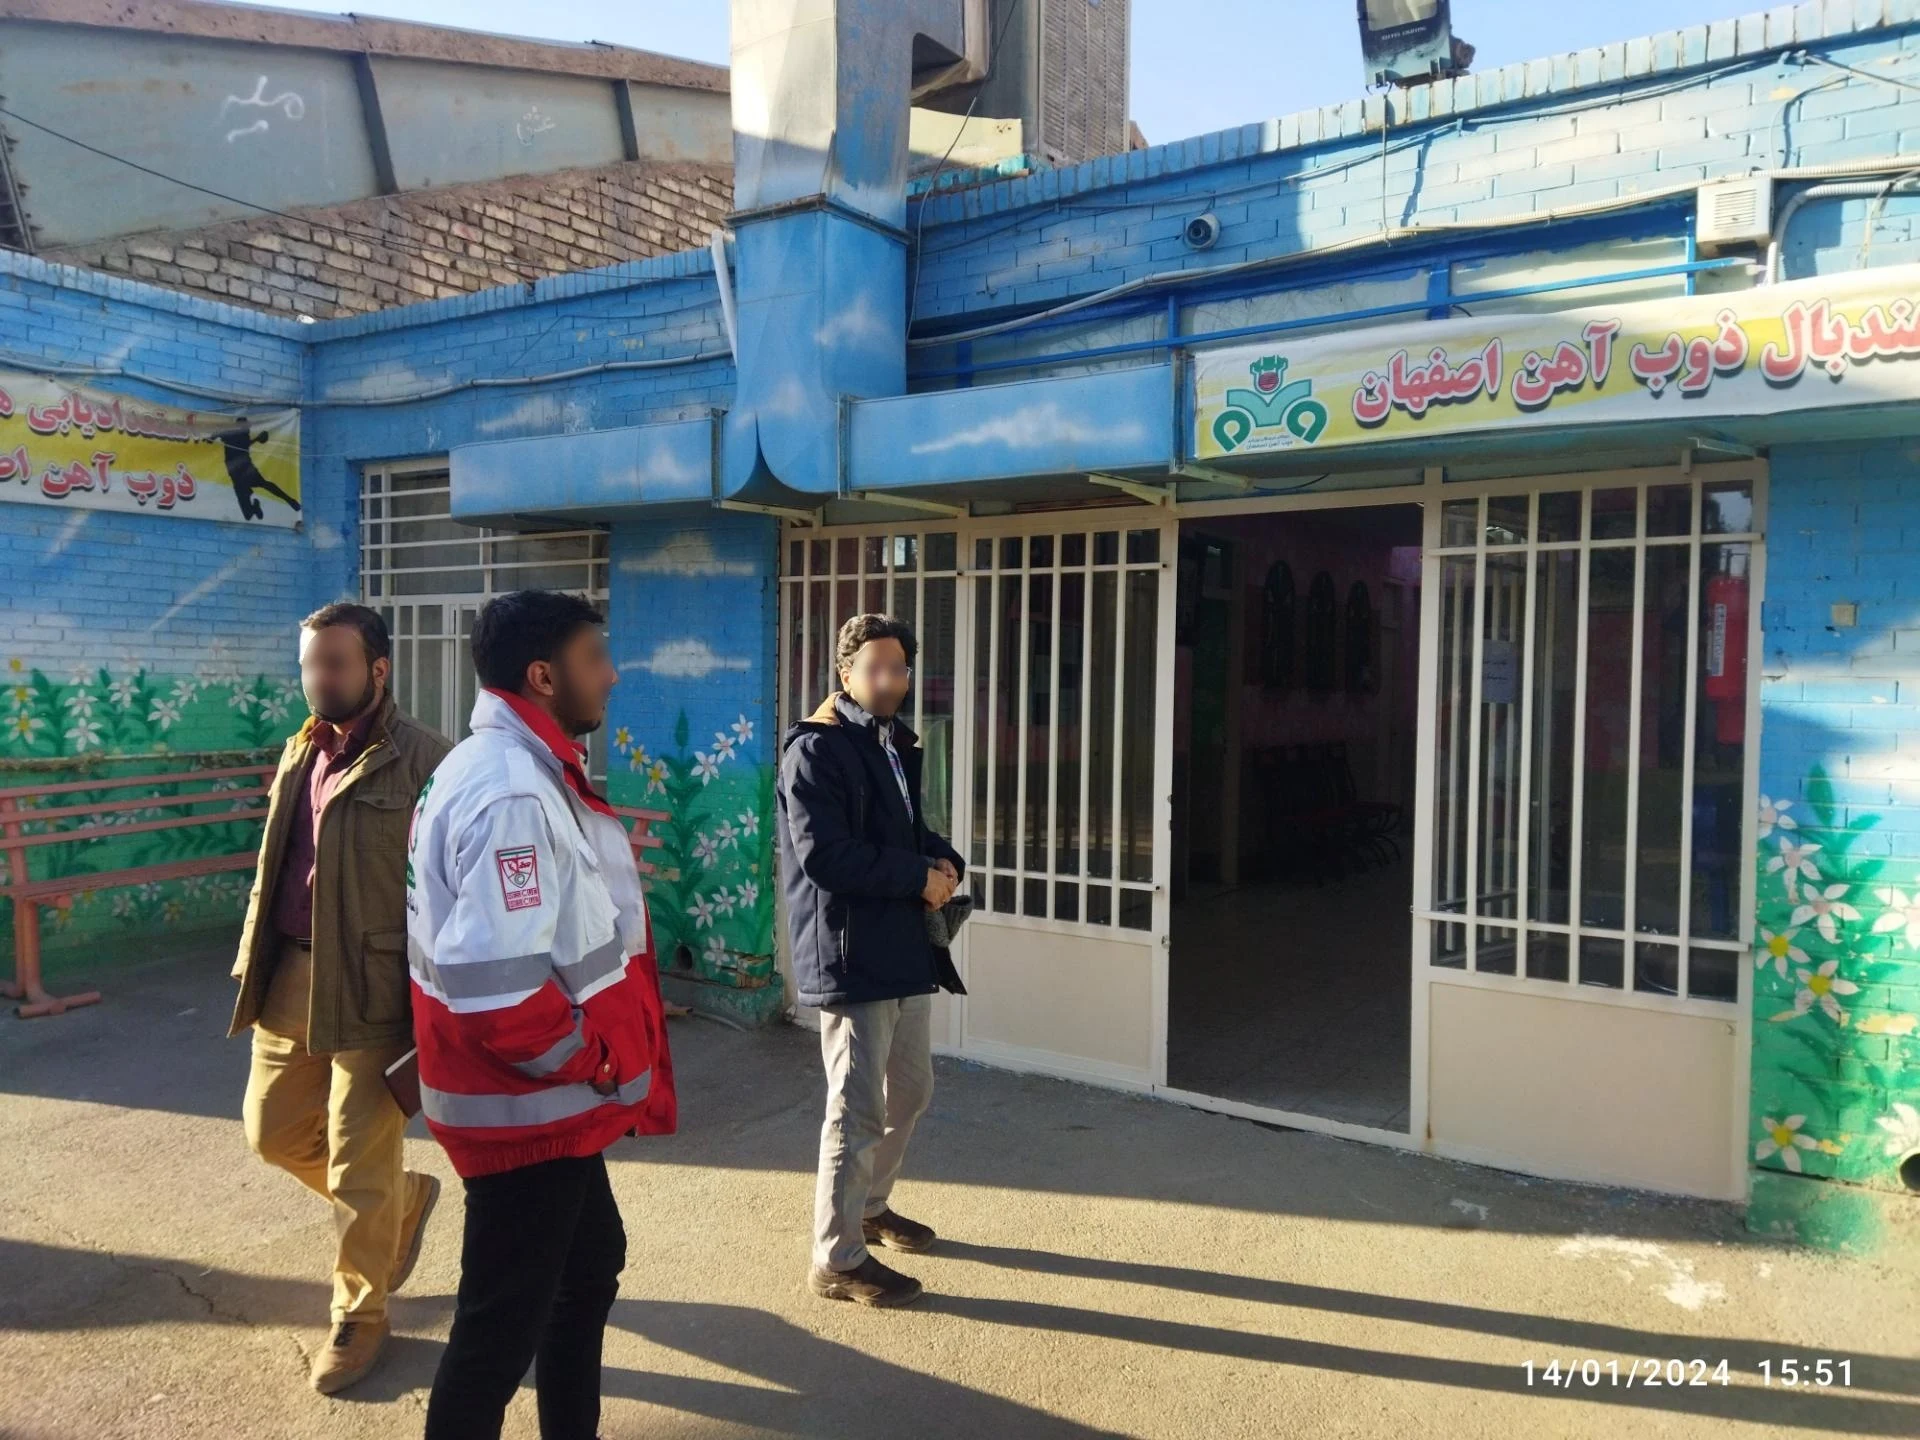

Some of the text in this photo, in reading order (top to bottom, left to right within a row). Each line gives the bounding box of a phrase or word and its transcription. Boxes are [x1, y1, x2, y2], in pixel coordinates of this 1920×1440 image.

[1353, 299, 1920, 421] ندبال ذوب آهن اصفهان
[41, 452, 115, 496] آهن
[125, 463, 196, 506] ذوب
